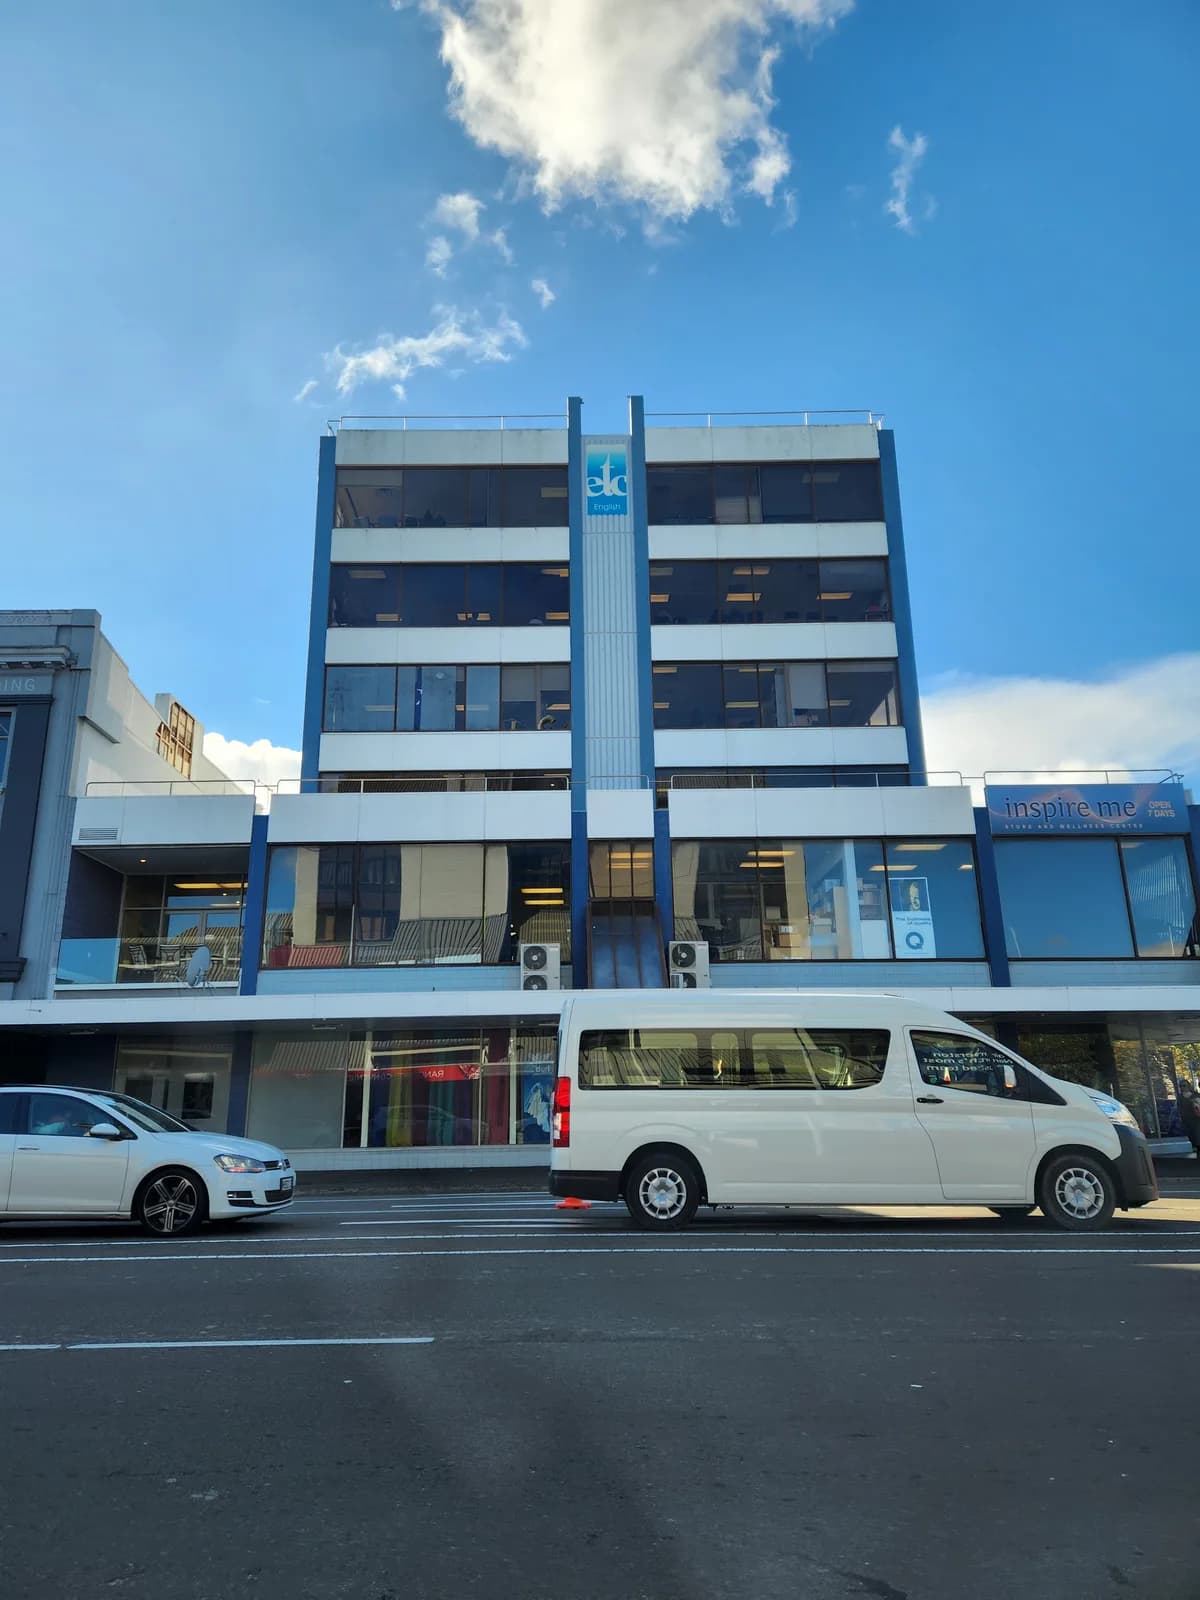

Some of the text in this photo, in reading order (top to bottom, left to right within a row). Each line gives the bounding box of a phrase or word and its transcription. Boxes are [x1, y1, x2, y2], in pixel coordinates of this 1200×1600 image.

[586, 452, 628, 497] etc
[593, 503, 621, 511] English
[0, 679, 36, 691] ING
[1005, 797, 1137, 822] inspire me
[1149, 801, 1172, 809] OPEN
[1147, 809, 1176, 818] 7 DAYS
